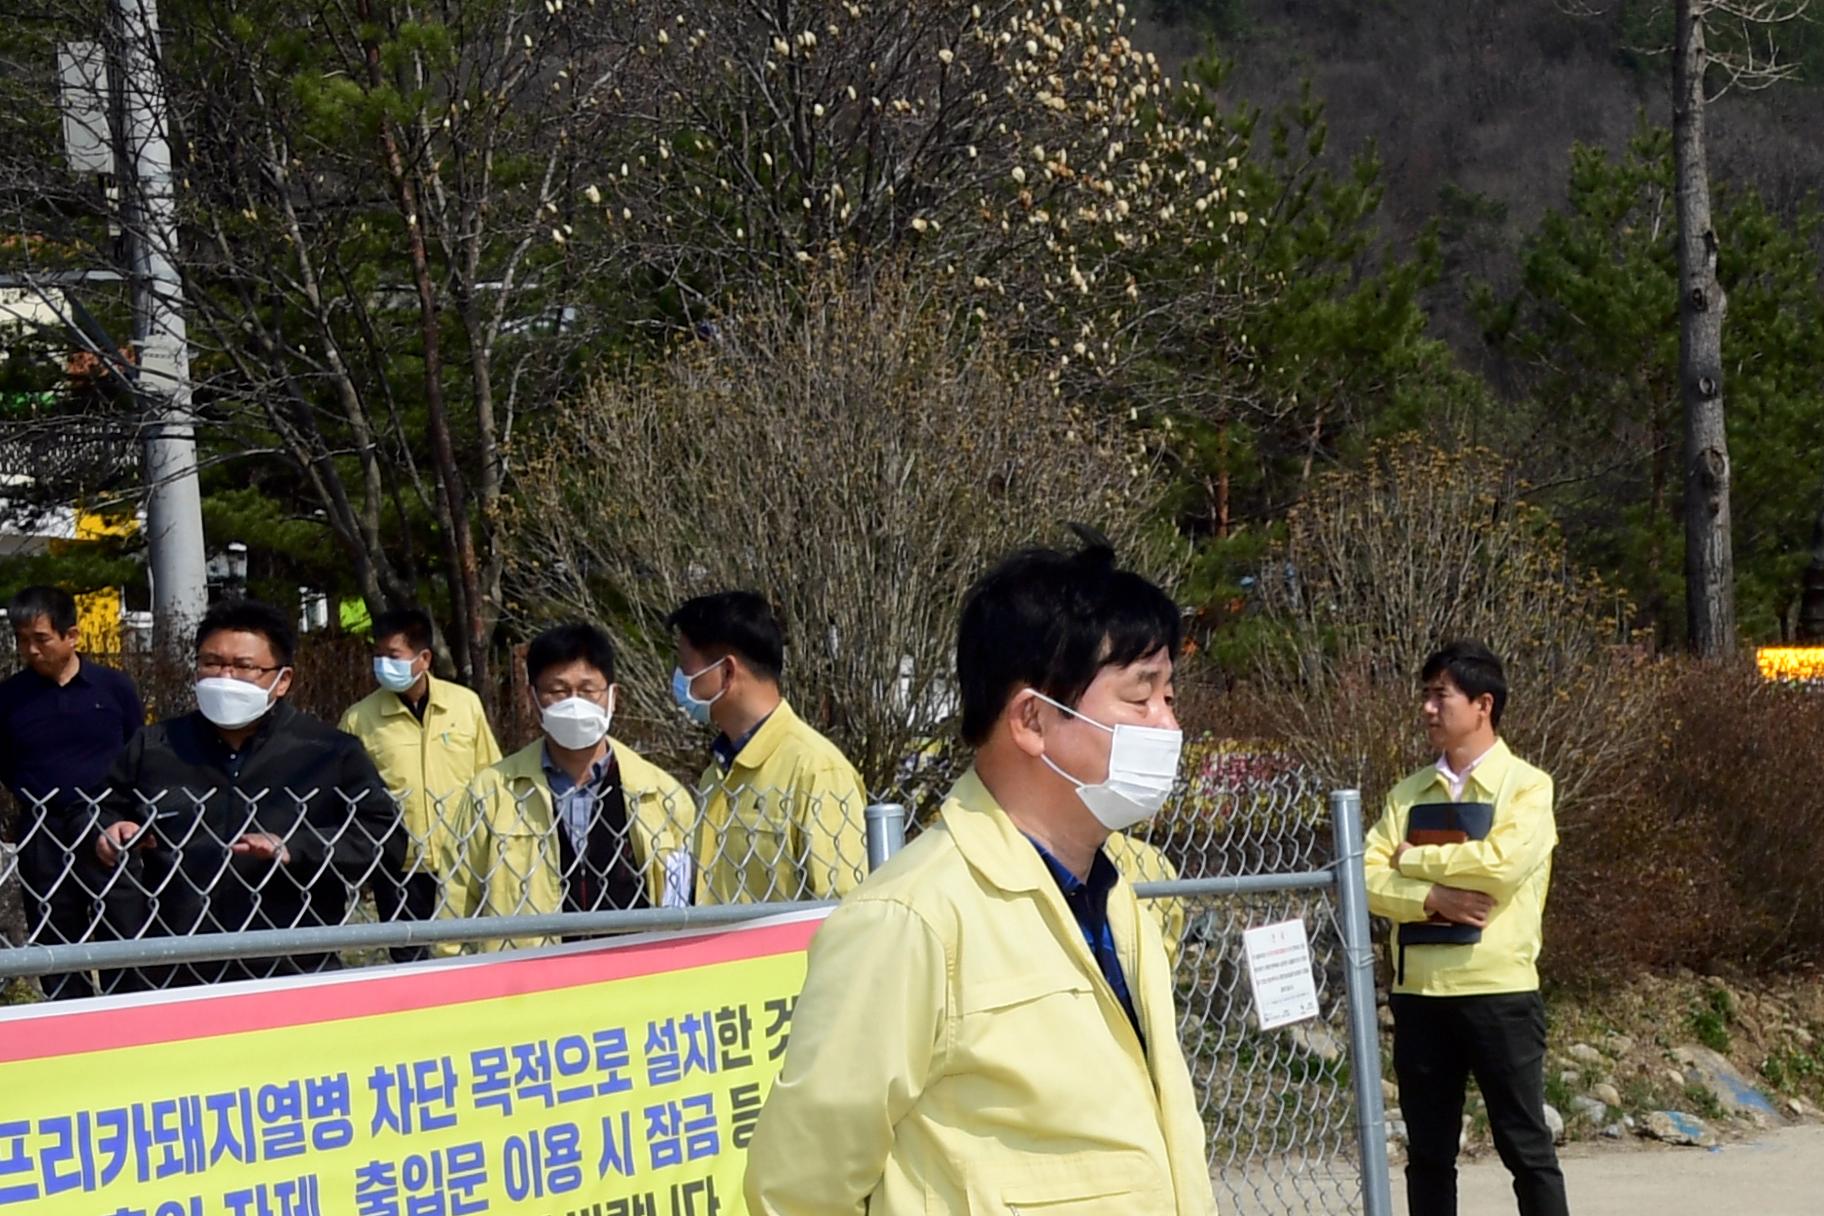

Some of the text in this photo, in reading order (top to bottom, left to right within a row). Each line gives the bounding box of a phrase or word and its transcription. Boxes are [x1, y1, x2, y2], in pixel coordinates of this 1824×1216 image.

[367, 1055, 458, 1138] 차단
[469, 1026, 634, 1116] 목적으로
[643, 1004, 753, 1087] 설치한
[503, 1122, 583, 1202] 이용
[598, 1110, 636, 1179] 시
[644, 1093, 721, 1170] 잠금
